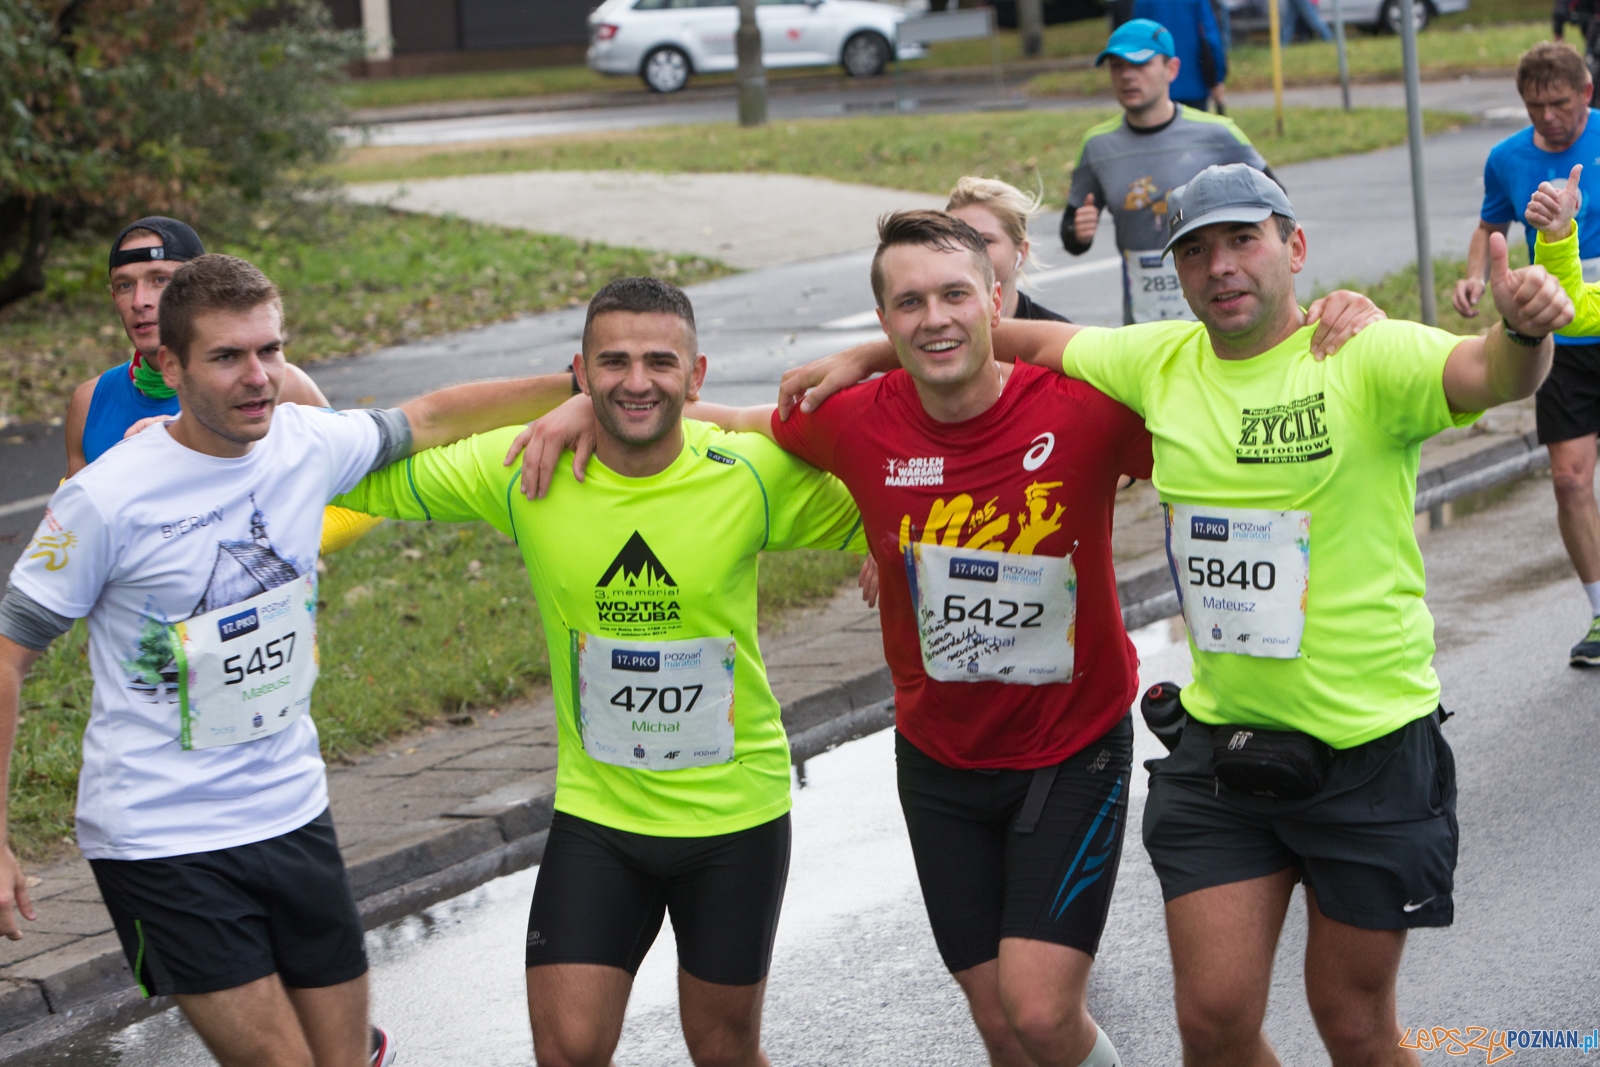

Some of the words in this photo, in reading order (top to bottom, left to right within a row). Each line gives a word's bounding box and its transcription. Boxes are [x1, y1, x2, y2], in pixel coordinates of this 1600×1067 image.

[1142, 274, 1180, 292] 283
[908, 457, 944, 468] ORLEN
[1268, 455, 1308, 464] POWIATU
[898, 467, 944, 477] WARSAW
[885, 476, 944, 486] MARATHON
[1232, 531, 1271, 540] maraton
[1002, 572, 1041, 583] maraton
[1188, 556, 1276, 591] 5840
[595, 589, 610, 600] 3.
[595, 601, 681, 611] WOJTKA
[1203, 596, 1256, 612] Mateusz
[598, 611, 681, 622] KOZUBA
[943, 594, 1044, 629] 6422
[224, 631, 296, 686] 5457
[664, 658, 701, 669] maraton
[242, 675, 291, 702] Mateusz
[610, 684, 703, 714] 4707
[631, 720, 681, 733] Michał
[664, 750, 681, 760] 4F
